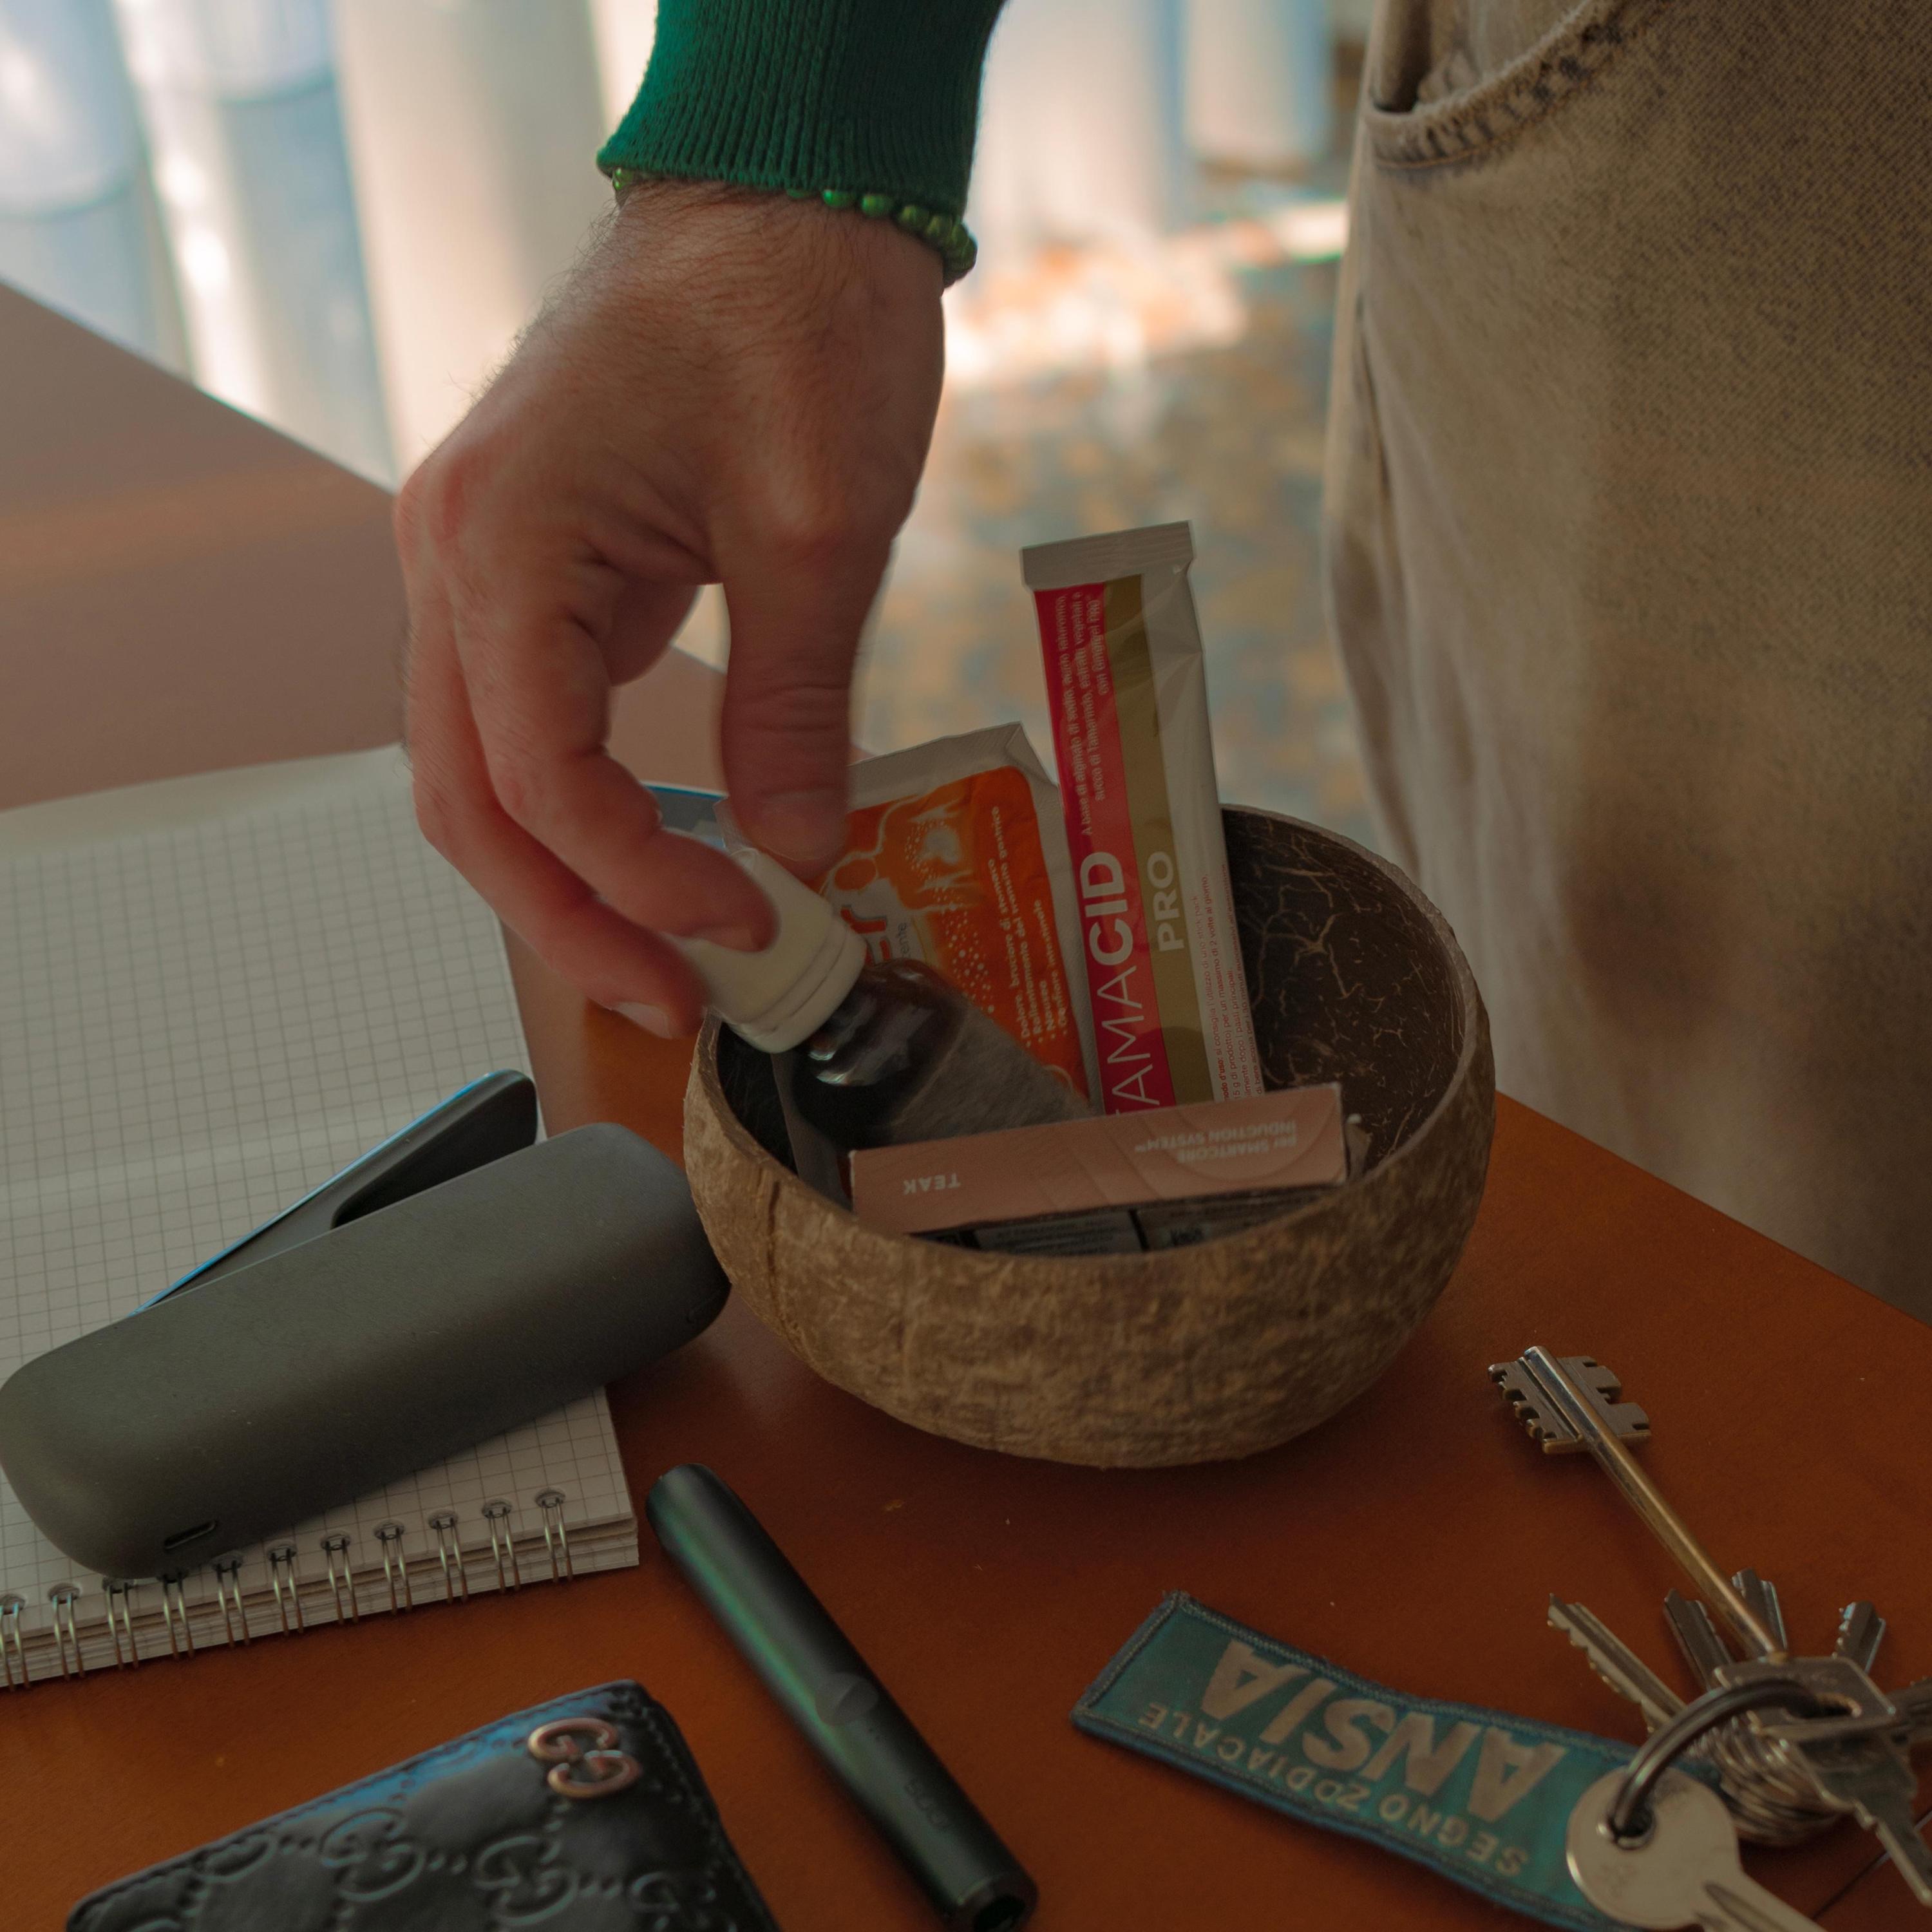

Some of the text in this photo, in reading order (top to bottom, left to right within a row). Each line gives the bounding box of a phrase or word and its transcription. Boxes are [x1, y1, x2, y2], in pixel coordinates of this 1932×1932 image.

[1072, 601, 1086, 645] vegetali
[1059, 654, 1073, 686] acido
[1074, 648, 1090, 689] estratti
[1097, 674, 1110, 695] con
[1067, 723, 1079, 735] di
[1070, 736, 1087, 781] alginato
[1088, 754, 1101, 766] di
[1076, 783, 1087, 794] di
[1094, 767, 1106, 801] succo
[1080, 797, 1091, 824] base
[989, 858, 1008, 915] stomaco
[1200, 873, 1212, 904] giorno,
[1146, 851, 1185, 952] PRO
[1191, 897, 1202, 918] pack
[990, 806, 1043, 1035] Rallentamento del transito gastrico
[998, 917, 1012, 932] di
[1193, 920, 1204, 940] stick
[1206, 916, 1216, 938] volte
[1004, 934, 1019, 988] bruciore
[1198, 942, 1207, 958] uno
[1210, 947, 1218, 956] di
[1032, 899, 1068, 1028] Gonfiore intestinale
[1200, 960, 1209, 969] di
[1204, 971, 1214, 1005] l'utilizzo
[1214, 958, 1226, 998] massimo
[1237, 973, 1246, 999] minuti
[1038, 980, 1056, 1031] Nausea
[1220, 999, 1227, 1010] un
[1210, 1008, 1221, 1046] consiglia
[1222, 1012, 1231, 1027] per
[1232, 1010, 1243, 1033] pasti
[1244, 1019, 1253, 1034] per
[1213, 1047, 1222, 1056] si
[1226, 1030, 1236, 1070] prodotto)
[1236, 1039, 1247, 1063] dopo
[1247, 1036, 1256, 1063] acqua
[1216, 1057, 1226, 1080] d'uso:
[1229, 1071, 1237, 1079] di
[1252, 1065, 1260, 1084] bere
[1255, 1086, 1262, 1094] di
[1207, 1120, 1297, 1144] INDUCTION
[1176, 1139, 1270, 1163] SMARTCORE
[902, 1172, 961, 1195] TEAK
[1197, 1637, 1569, 1824] ANSIA
[1136, 1700, 1530, 1877] SEGNO ZODIACALE
